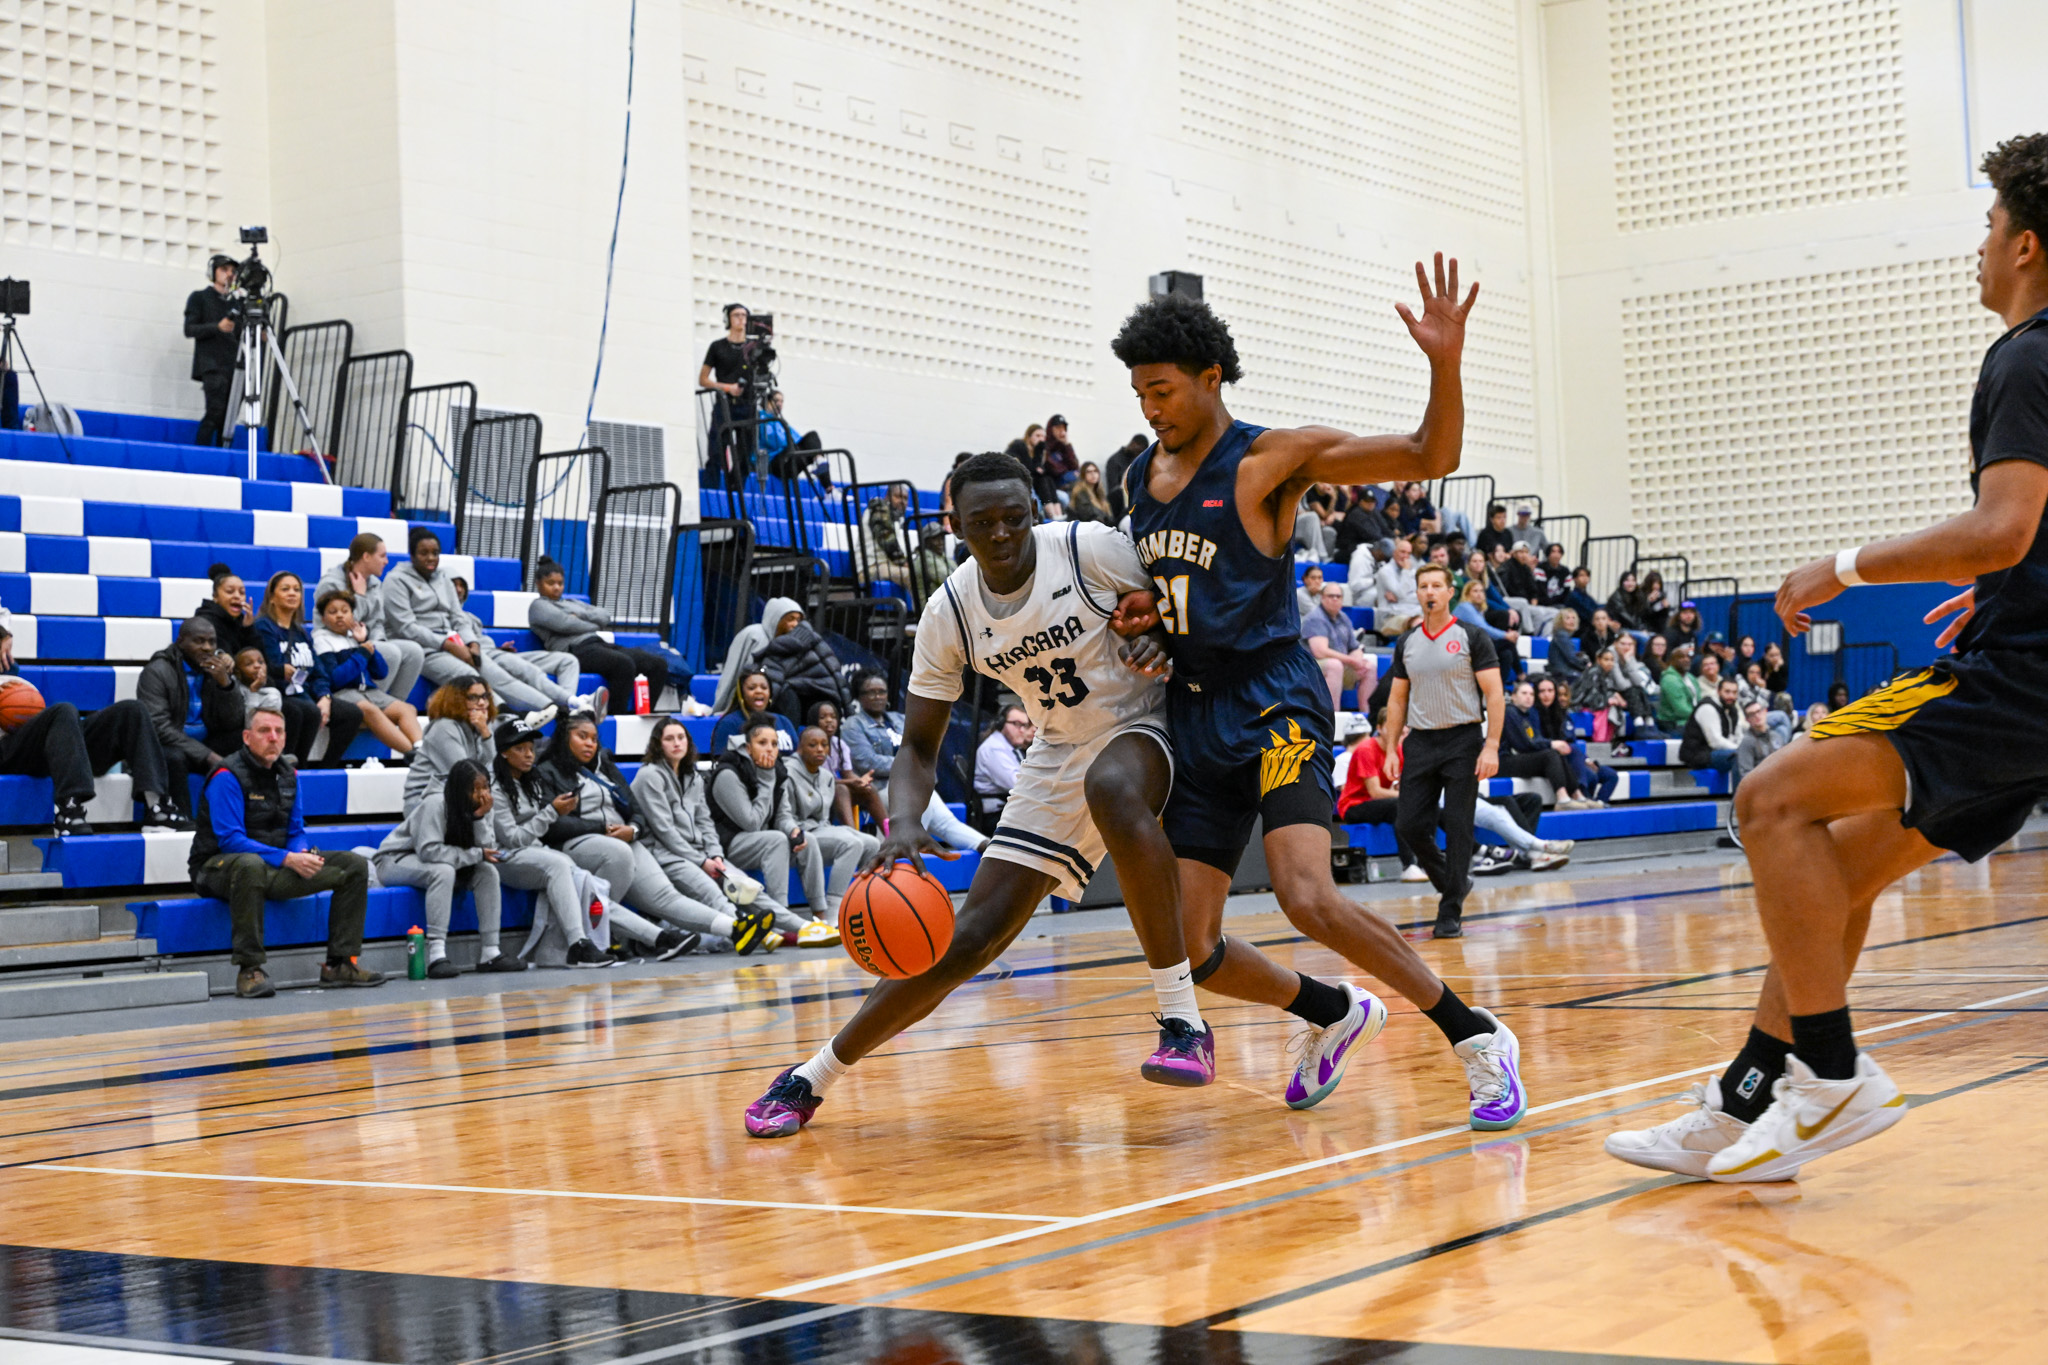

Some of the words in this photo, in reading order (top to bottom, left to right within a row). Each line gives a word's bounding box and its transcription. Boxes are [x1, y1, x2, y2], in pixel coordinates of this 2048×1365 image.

[1153, 574, 1190, 635] 21
[1023, 657, 1090, 710] 33
[848, 910, 889, 977] Wilso
